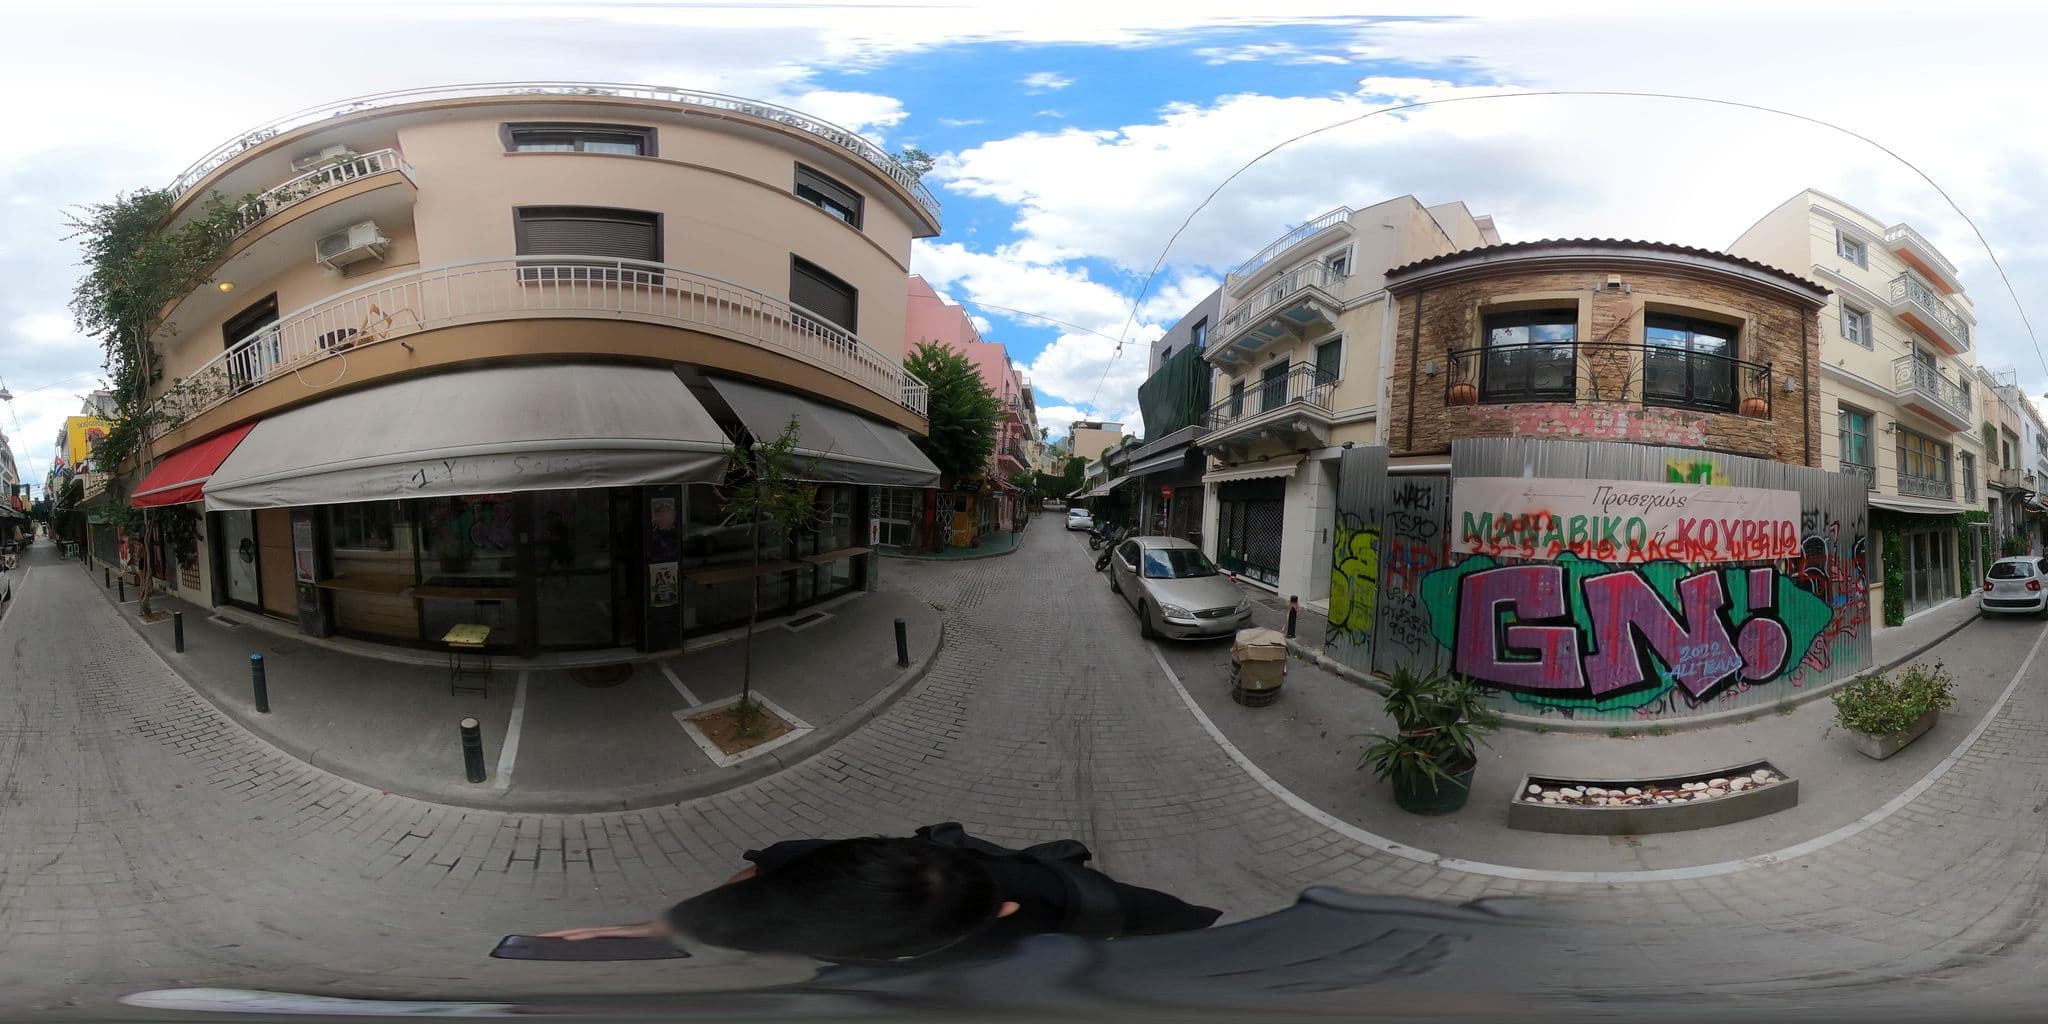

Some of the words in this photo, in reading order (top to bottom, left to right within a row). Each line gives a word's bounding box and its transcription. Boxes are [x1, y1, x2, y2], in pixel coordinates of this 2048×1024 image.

[1592, 485, 1688, 514] Προσεχώς
[1461, 510, 1647, 551] ΜΑΝΑΒΙΚΟ
[1676, 516, 1796, 551] ΚΟΥΡΕΙΟ
[1452, 562, 1793, 702] GN!
